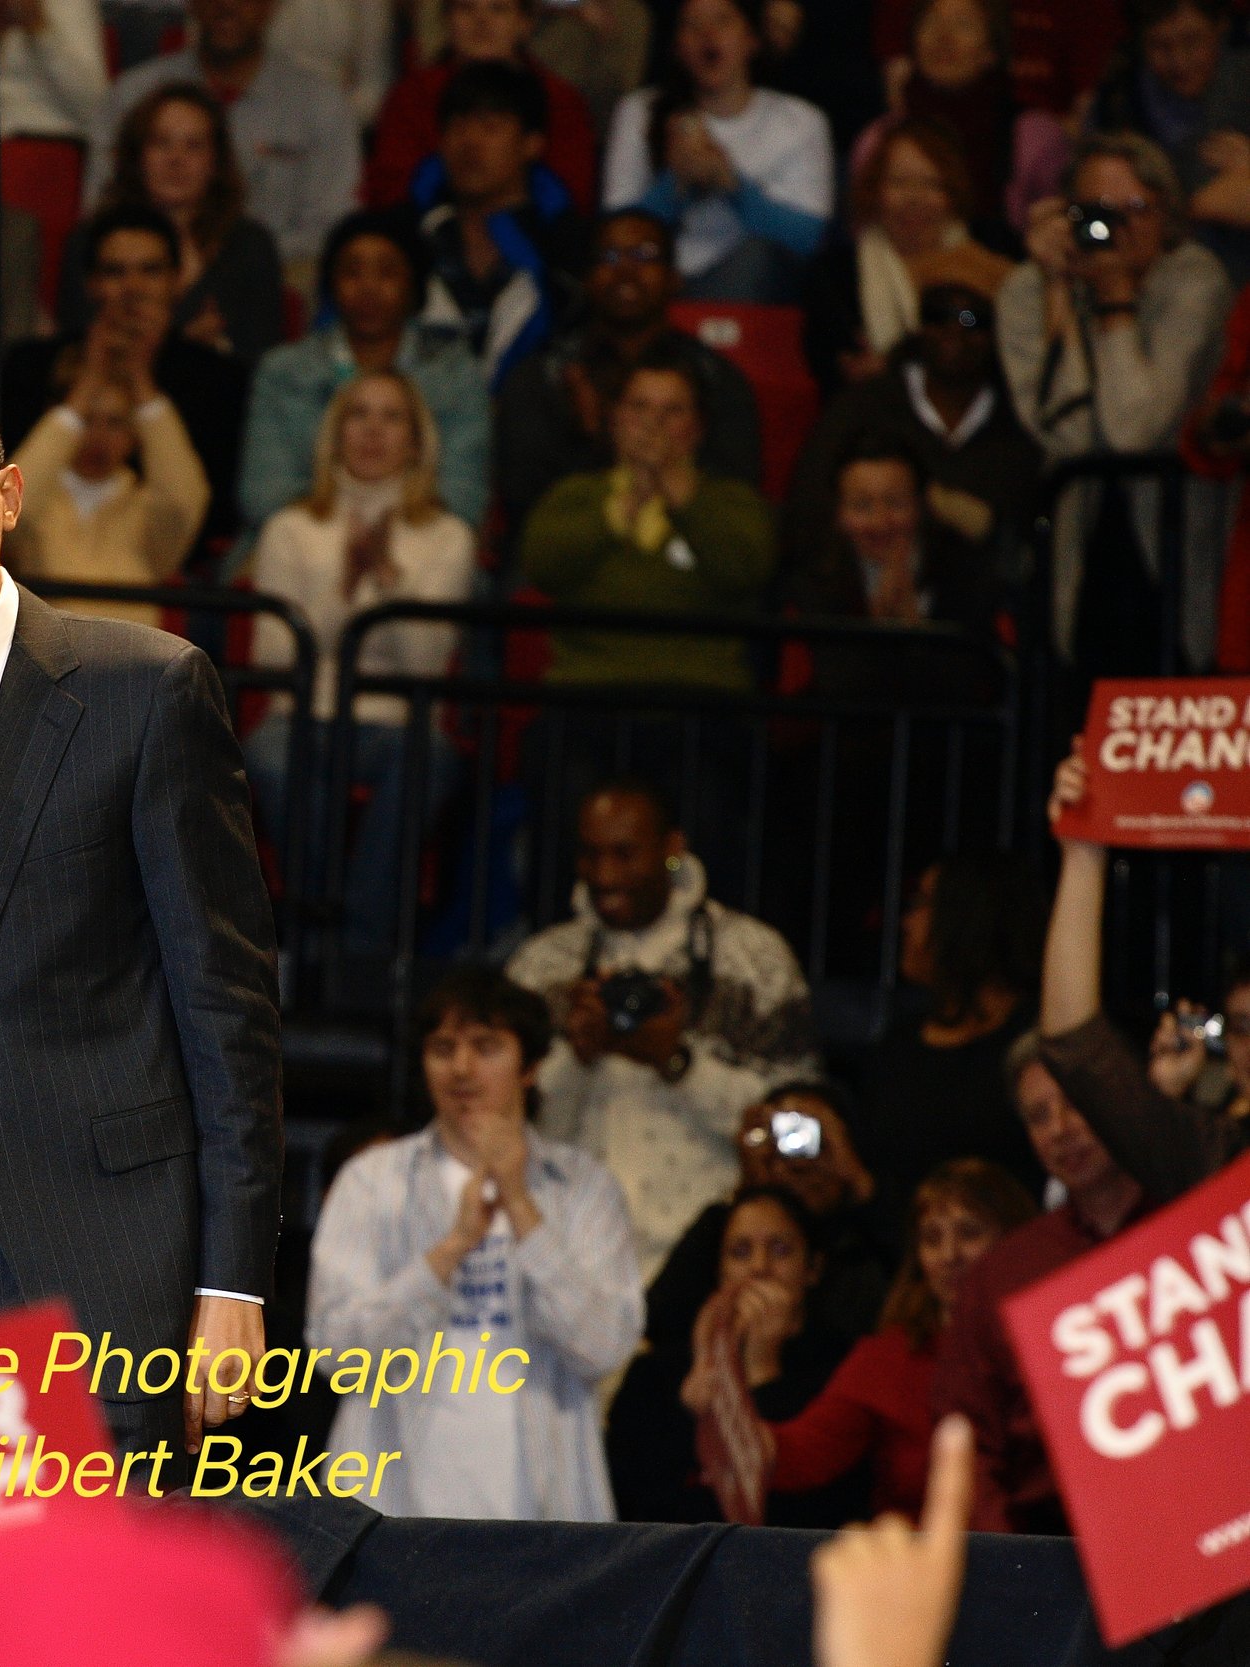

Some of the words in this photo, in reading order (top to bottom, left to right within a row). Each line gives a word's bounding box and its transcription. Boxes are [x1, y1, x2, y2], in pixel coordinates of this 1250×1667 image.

[1108, 695, 1237, 729] STAND
[1100, 729, 1250, 772] CHAN
[1052, 1198, 1250, 1378] STAN
